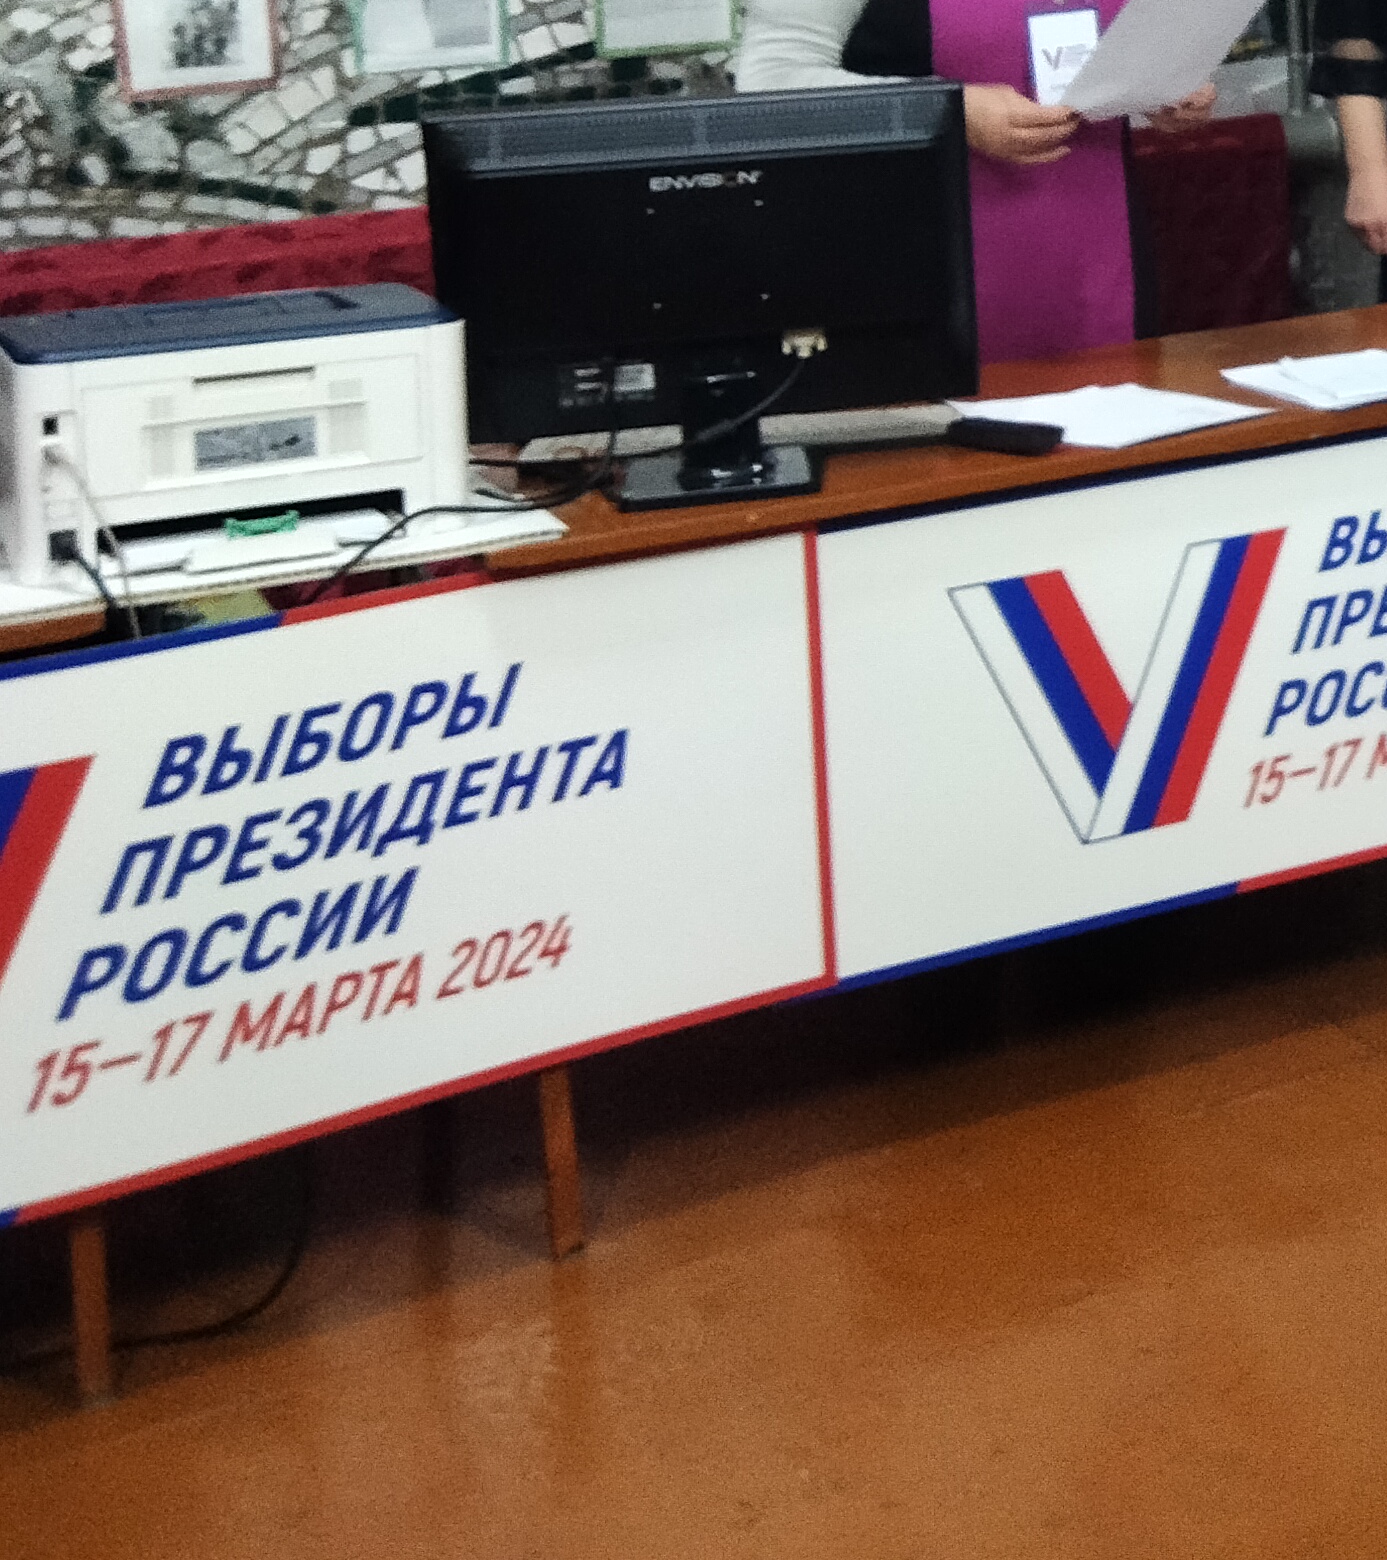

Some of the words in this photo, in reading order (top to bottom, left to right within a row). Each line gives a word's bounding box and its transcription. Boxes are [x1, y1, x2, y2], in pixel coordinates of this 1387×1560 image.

[142, 662, 523, 810] ВЫБОРЫ
[99, 728, 631, 915] ПРЕЗИДЕНТА
[55, 866, 420, 1022] РОССИИ
[219, 953, 426, 1063] МАРТА
[435, 915, 573, 1000] 2024
